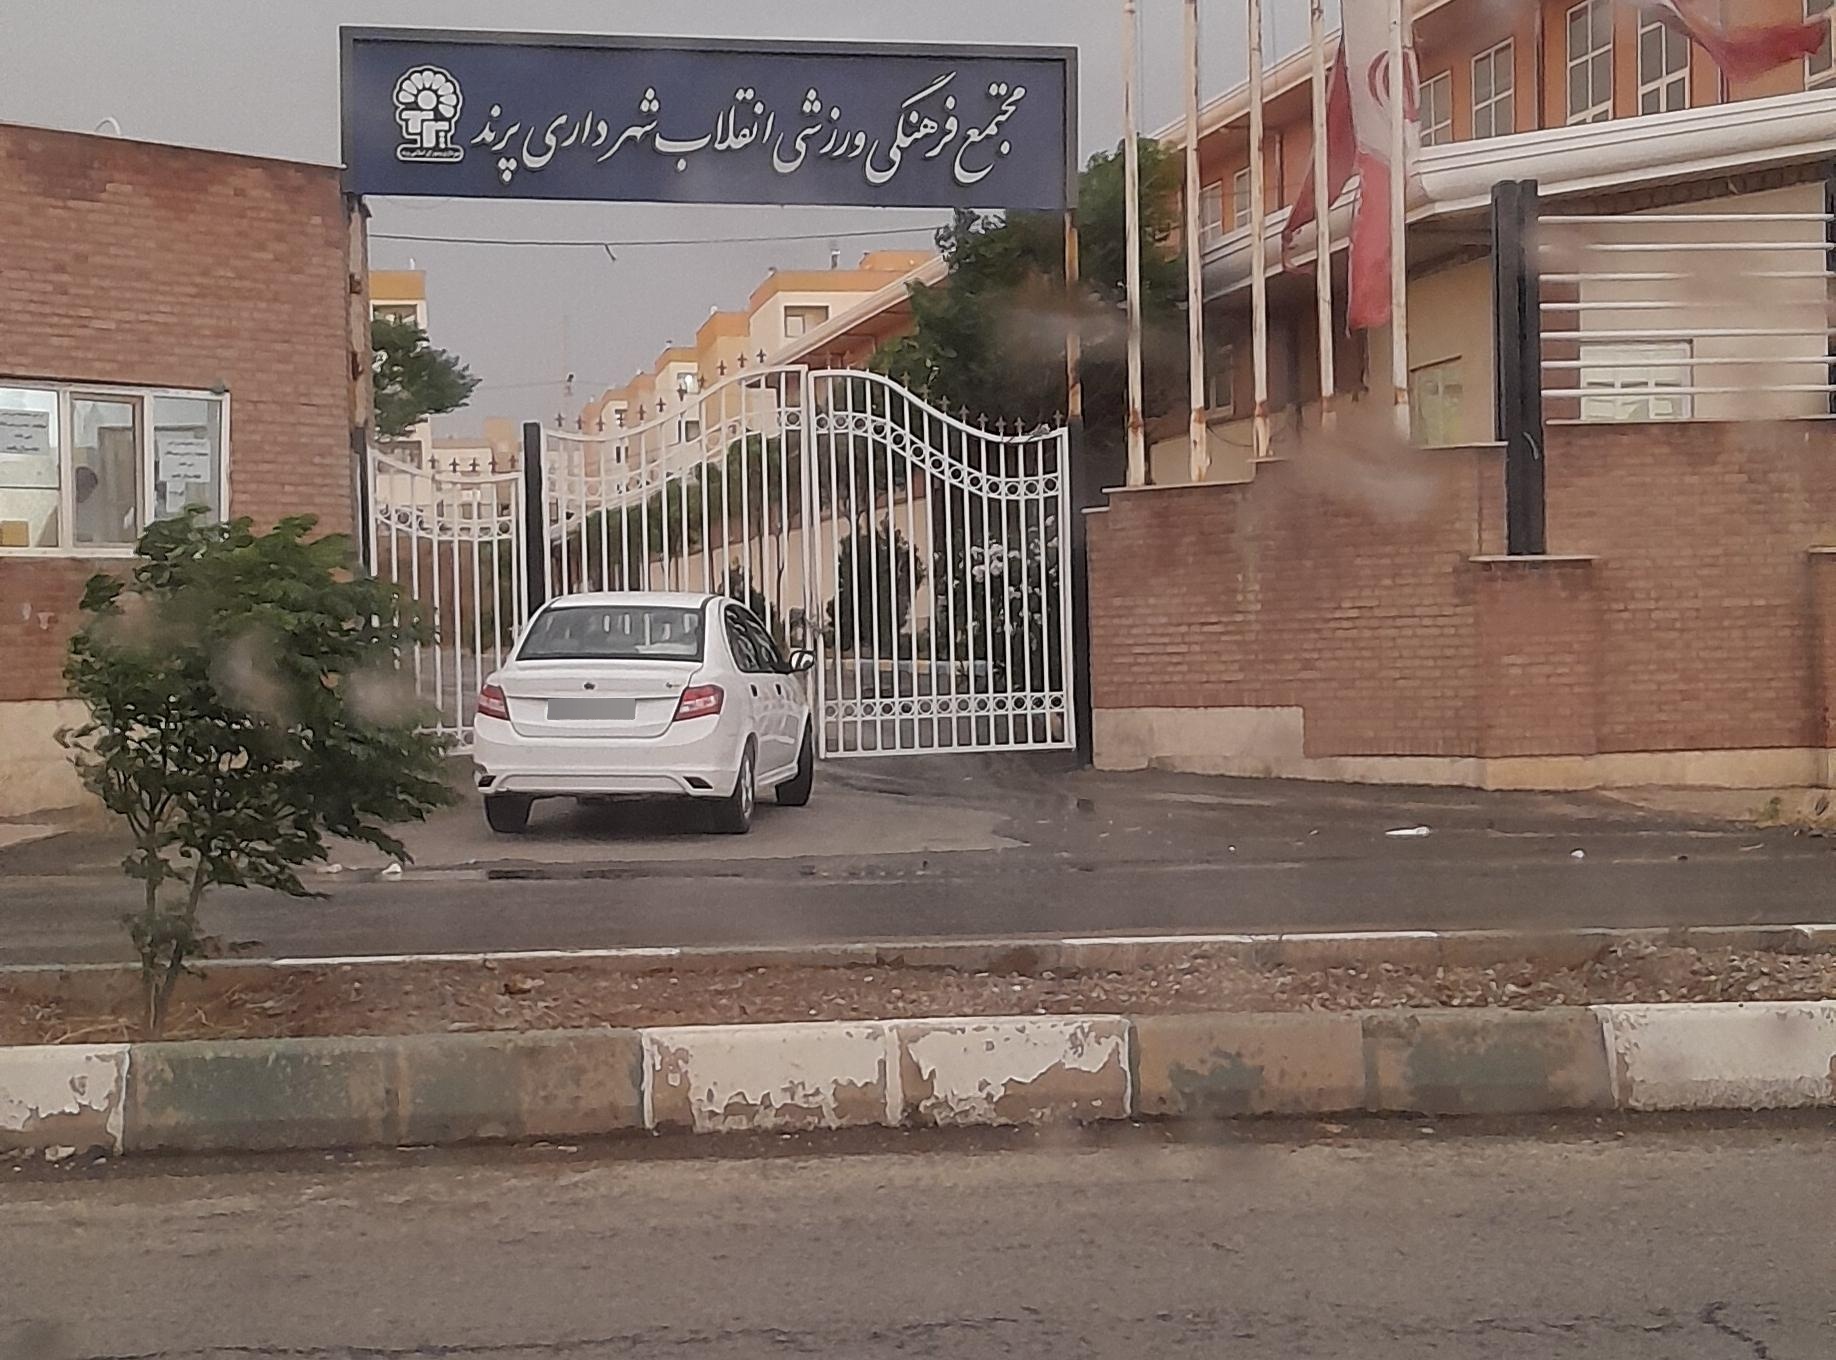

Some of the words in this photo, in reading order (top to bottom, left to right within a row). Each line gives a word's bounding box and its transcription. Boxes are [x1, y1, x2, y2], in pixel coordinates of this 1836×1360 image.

[470, 104, 521, 183] پرند
[522, 88, 660, 168] شهرداری
[655, 88, 775, 171] انقلاب
[772, 88, 867, 174] ورزشی
[865, 71, 959, 184] فرهنگی
[954, 82, 1026, 183] مجتمع
